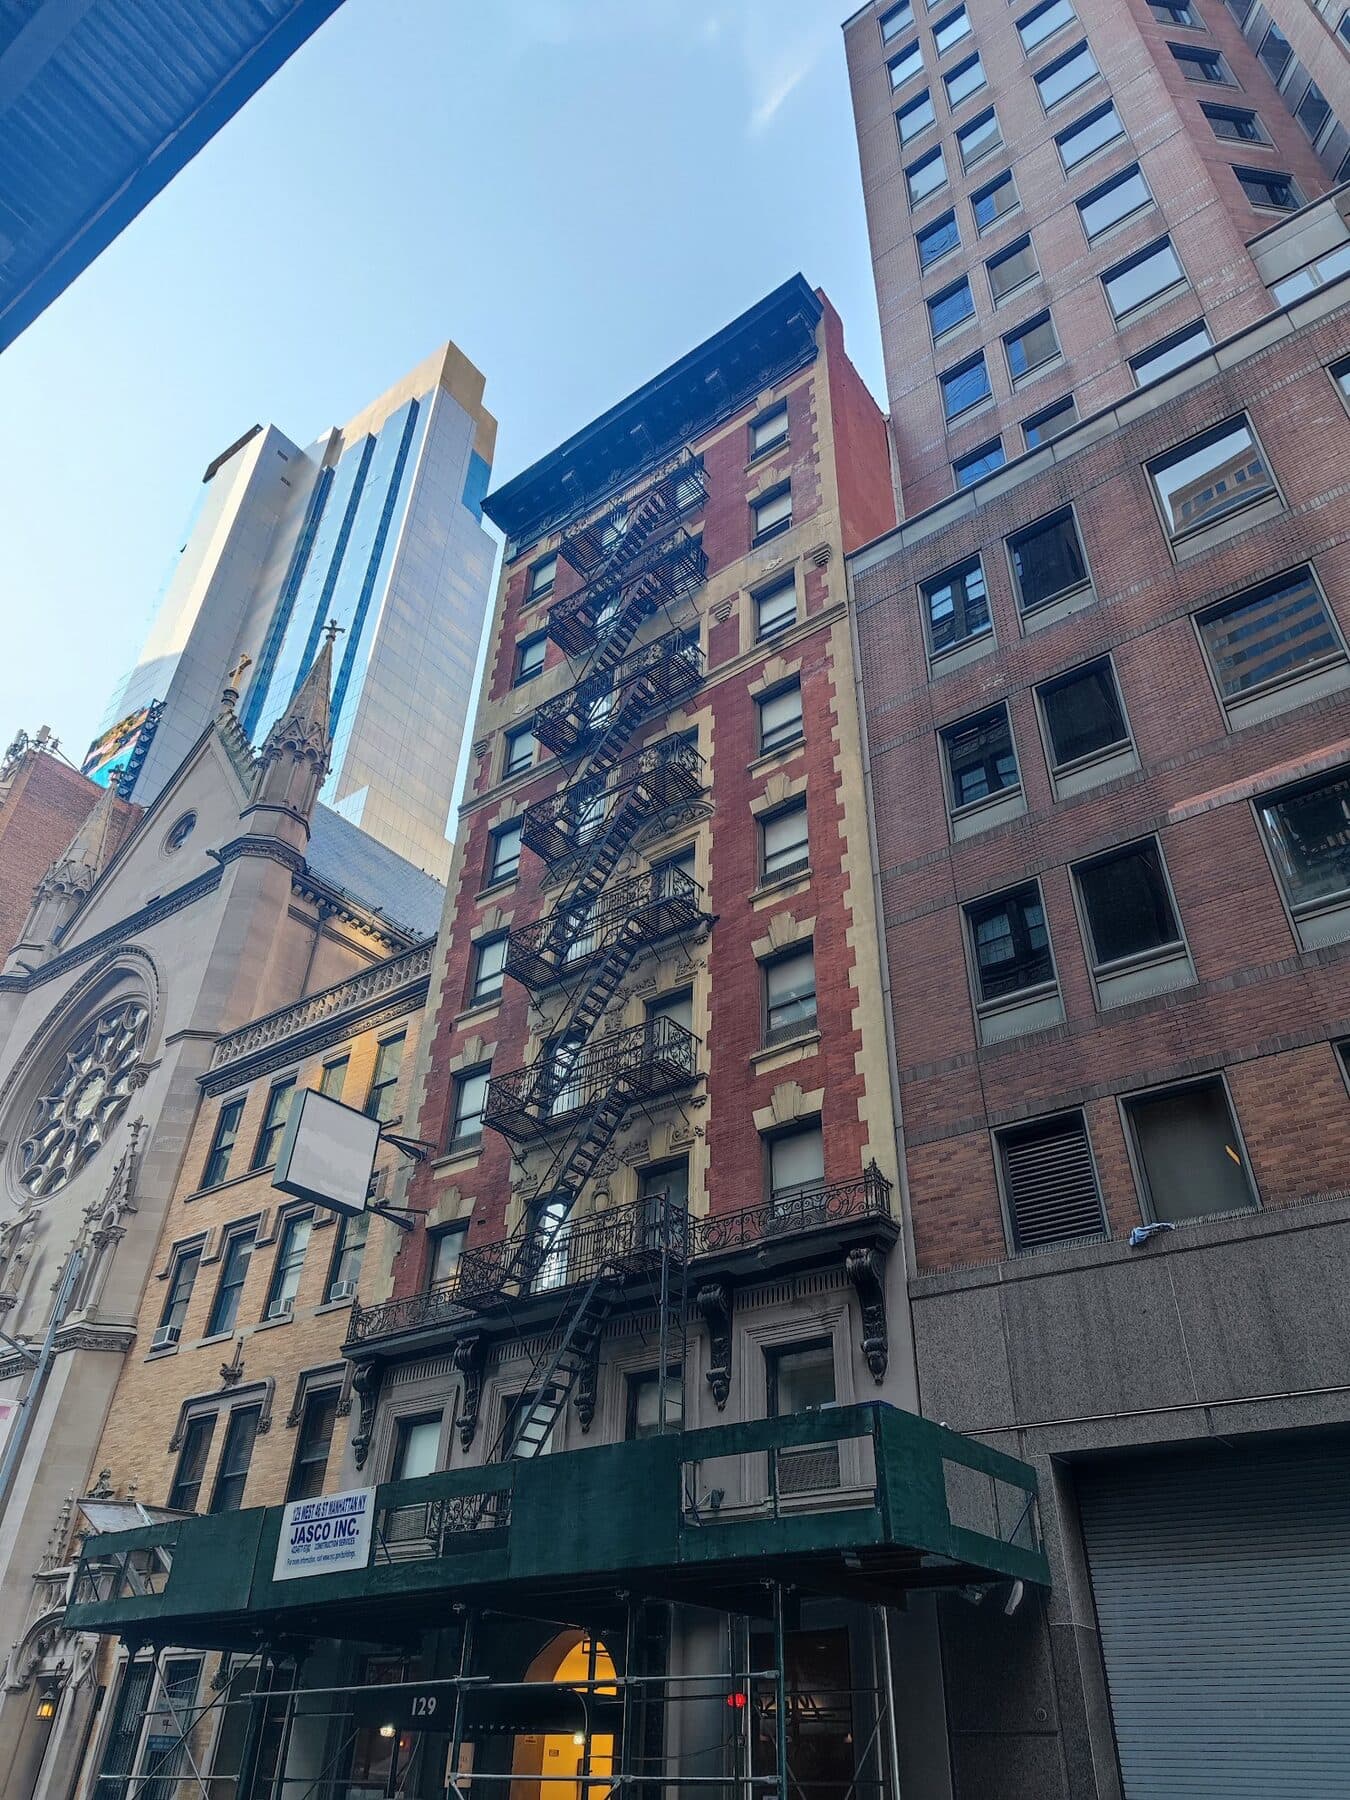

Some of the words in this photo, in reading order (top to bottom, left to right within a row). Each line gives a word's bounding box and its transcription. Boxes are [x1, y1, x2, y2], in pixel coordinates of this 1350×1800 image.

[301, 1504, 315, 1520] WEST
[322, 1501, 329, 1517] ST
[328, 1496, 358, 1515] MANHATTAN
[358, 1494, 367, 1511] NY
[291, 1522, 330, 1545] JASCO
[334, 1518, 359, 1539] INC.
[338, 1537, 355, 1547] SERVICES
[411, 1696, 437, 1716] 129
